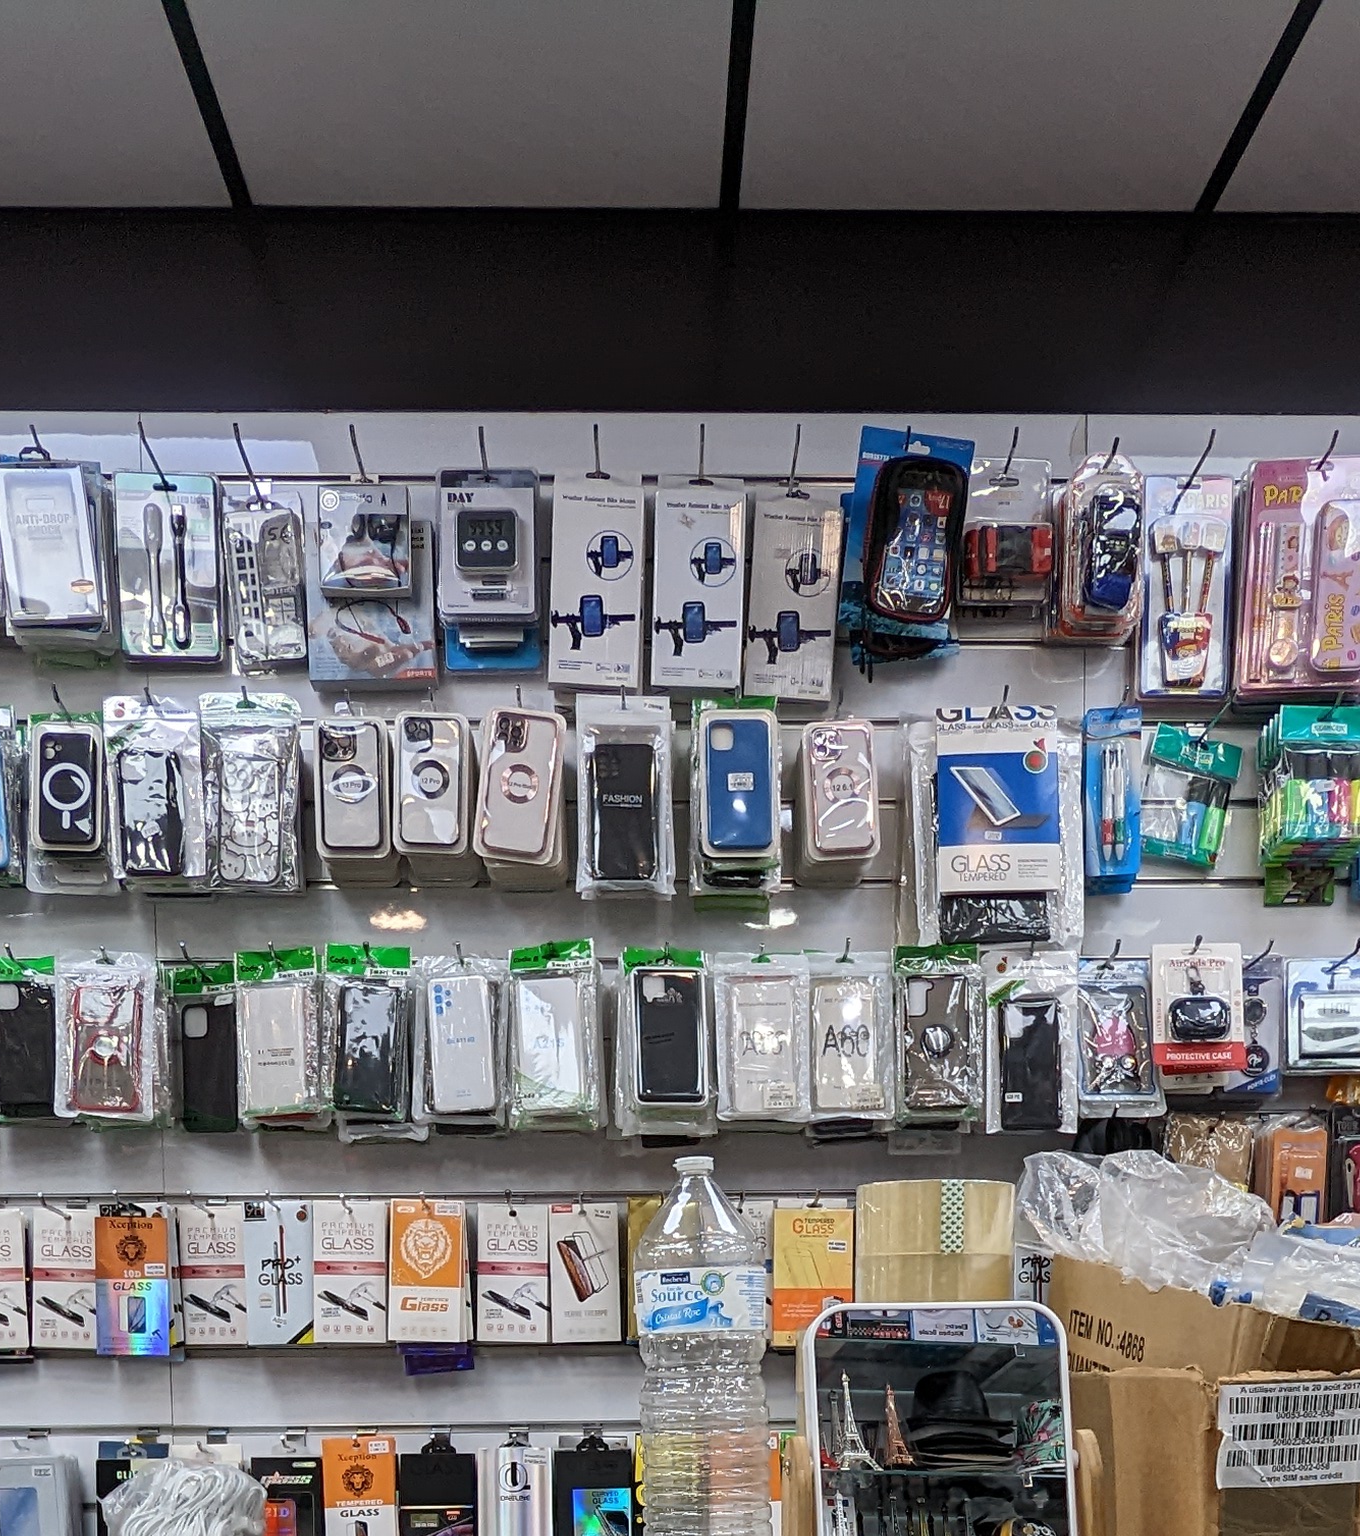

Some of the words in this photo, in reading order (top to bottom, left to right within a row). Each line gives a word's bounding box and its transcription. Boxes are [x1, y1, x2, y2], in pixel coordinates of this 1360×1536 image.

[446, 491, 475, 503] DAY
[1187, 491, 1230, 509] PARIS
[15, 512, 72, 526] ANTI-DROP
[602, 793, 643, 804] FASHION
[950, 853, 1011, 874] GLASS
[958, 870, 1008, 883] TEMPERED
[1166, 1051, 1211, 1061] PROTECTIVE
[1211, 1050, 1233, 1060] CASE
[108, 1218, 153, 1231] Xception
[186, 1241, 237, 1256] GLASS
[321, 1237, 376, 1251] GLASS
[486, 1238, 539, 1252] GLASS
[40, 1244, 93, 1259] GLASS
[111, 1280, 153, 1292] GLASS
[257, 1272, 304, 1287] GLASS
[649, 1287, 704, 1303] Source
[399, 1296, 450, 1314] Glass
[1068, 1309, 1094, 1340] ITEM
[337, 1453, 378, 1463] Xception
[335, 1499, 384, 1508] TEMPERED
[339, 1507, 381, 1519] GLASS
